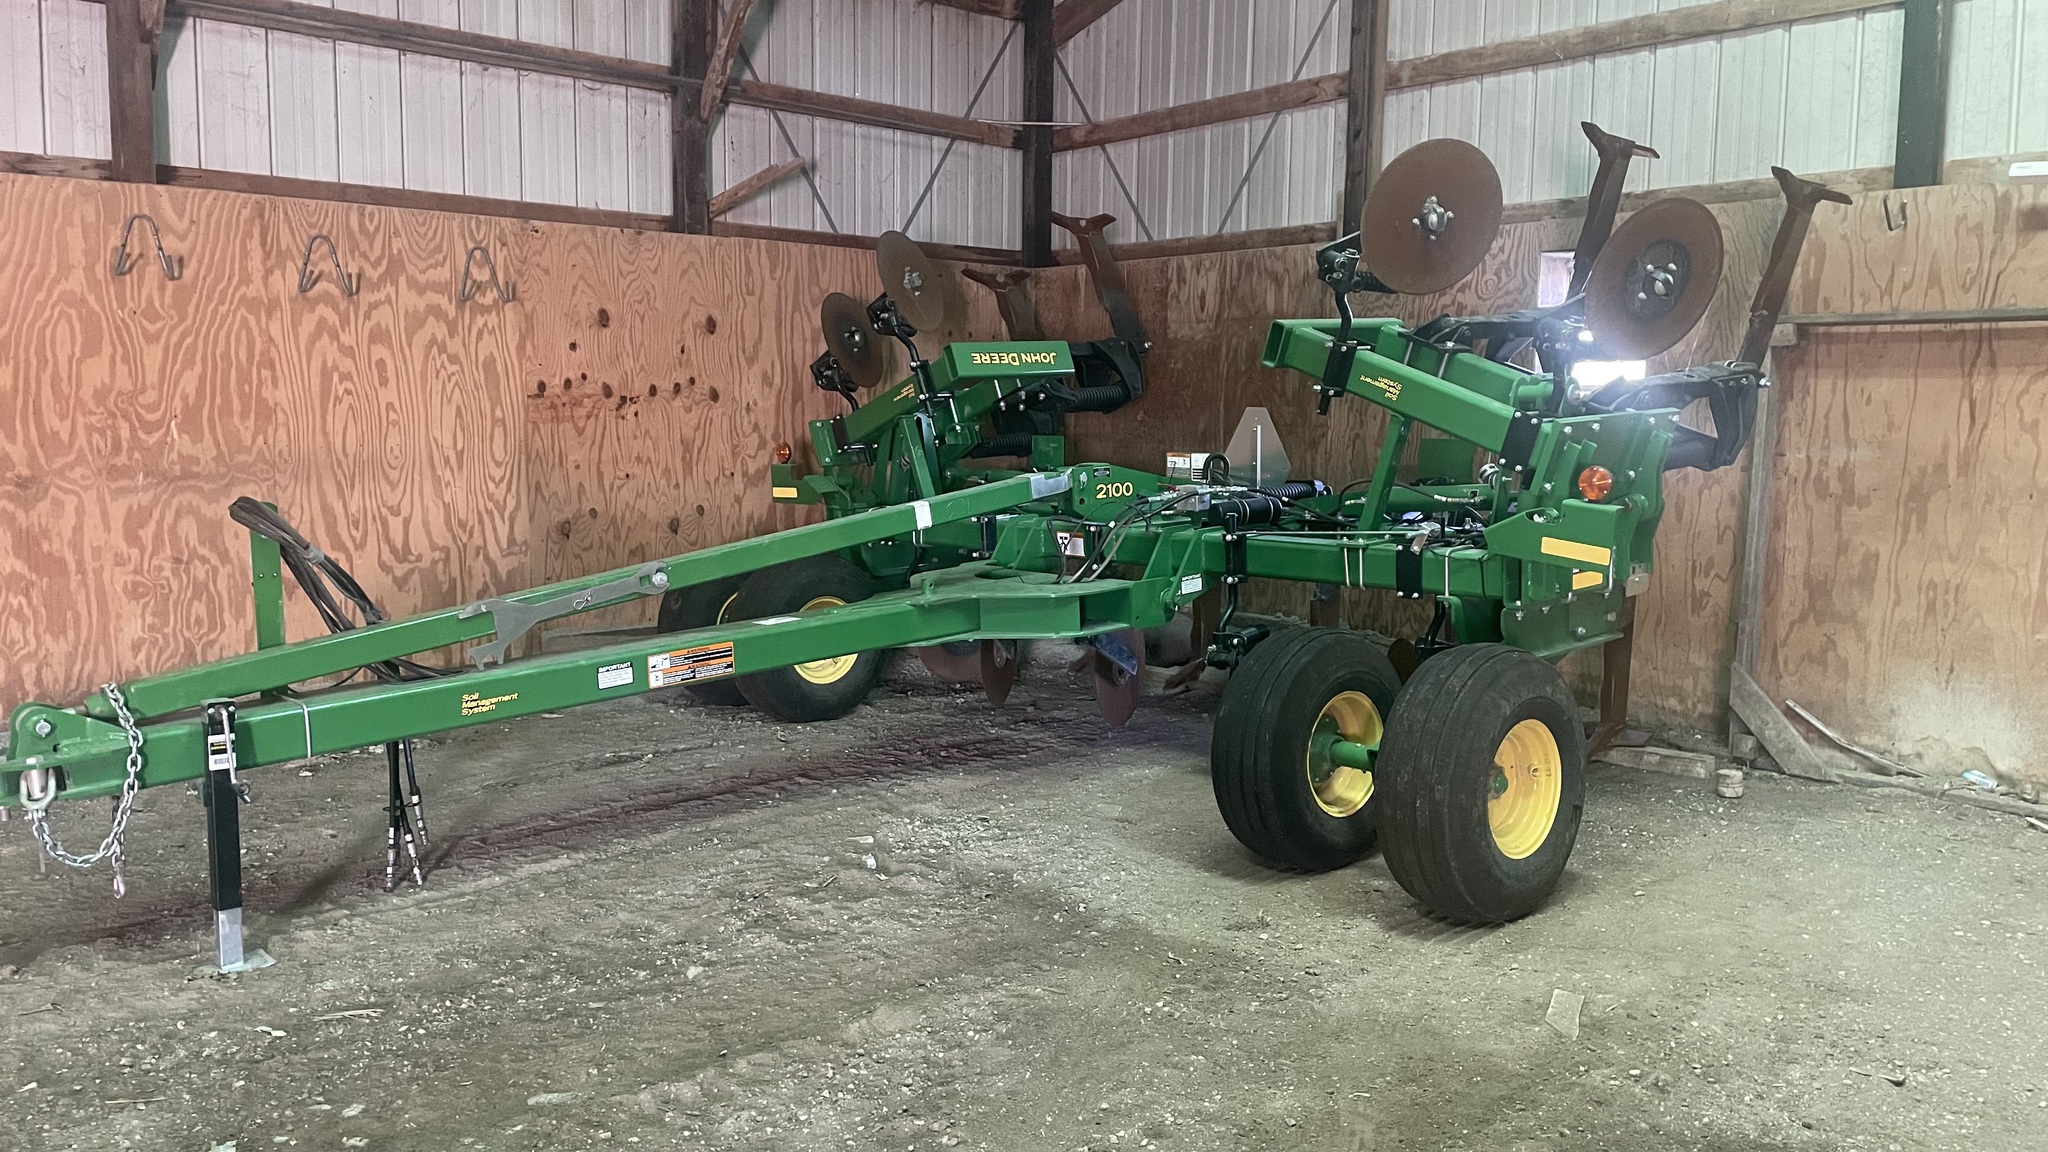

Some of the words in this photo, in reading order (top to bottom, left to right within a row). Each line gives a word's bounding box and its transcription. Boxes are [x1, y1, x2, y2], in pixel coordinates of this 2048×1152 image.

[971, 352, 1020, 366] DEERE
[1020, 352, 1057, 365] JOHN
[1095, 481, 1134, 499] 2100
[461, 692, 480, 702] Soil
[461, 692, 519, 709] Management
[461, 704, 496, 716] System
